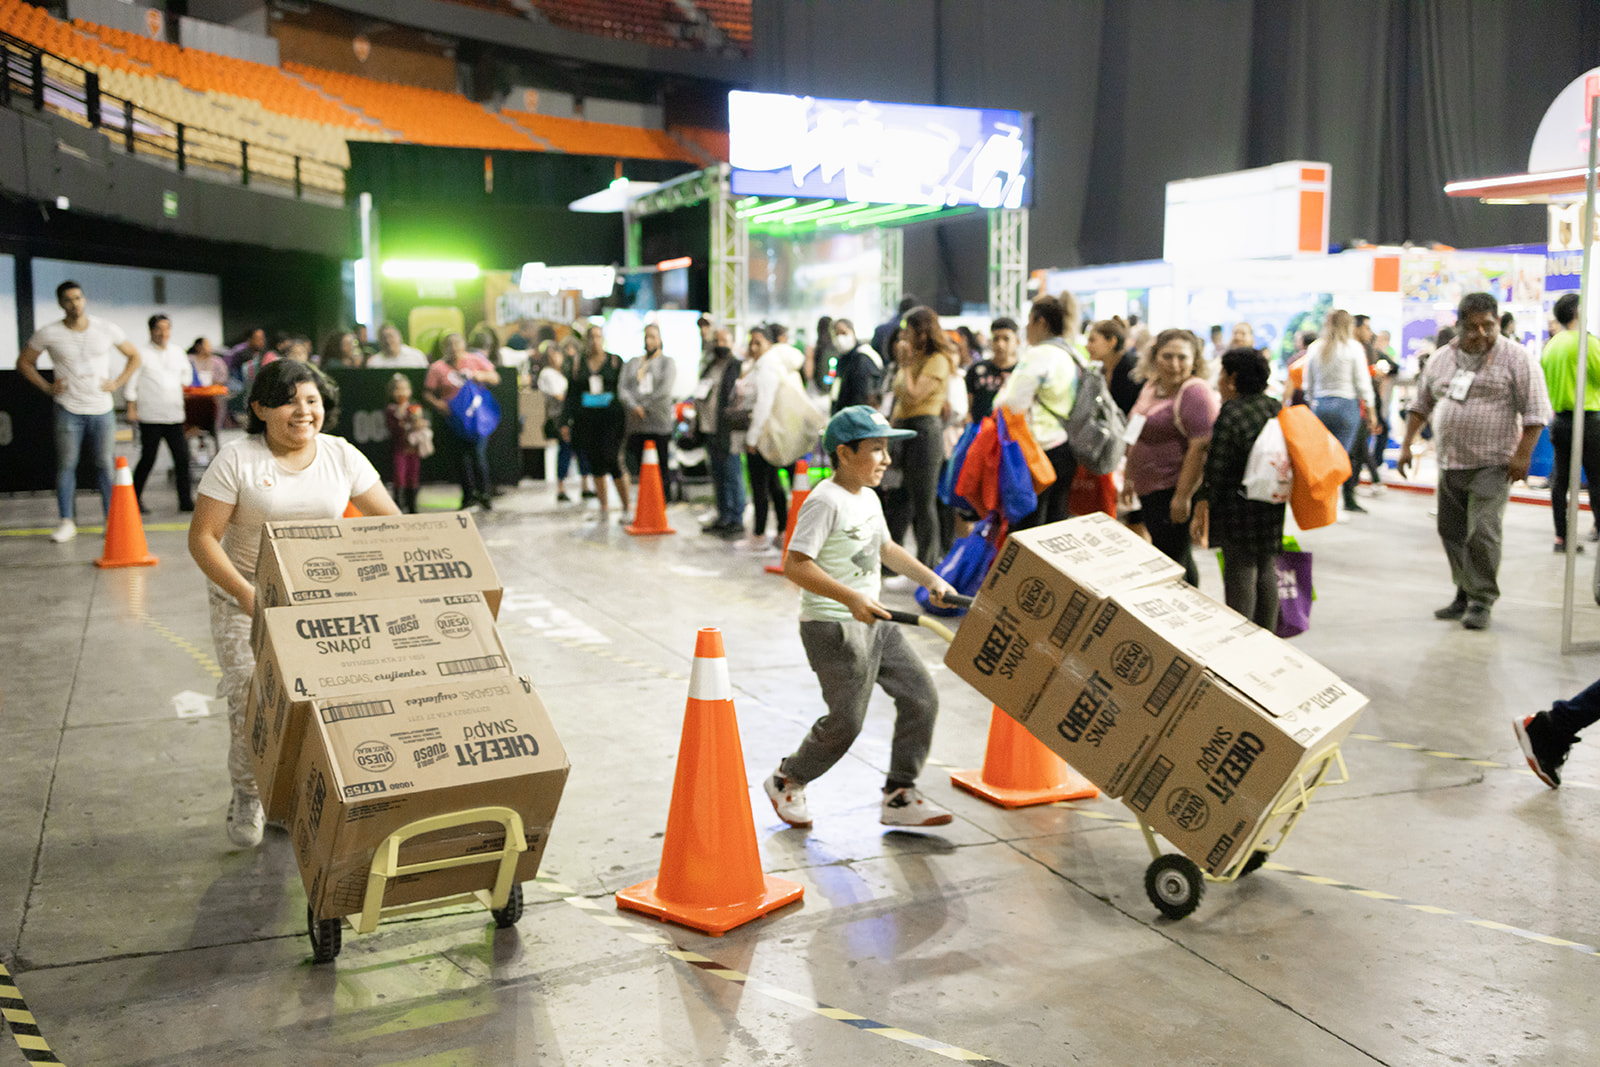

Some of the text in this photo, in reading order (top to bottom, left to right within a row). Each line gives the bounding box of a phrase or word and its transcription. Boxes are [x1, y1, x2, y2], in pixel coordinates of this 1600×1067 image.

[456, 514, 469, 529] 4
[306, 566, 340, 578] QUESO
[1021, 579, 1046, 614] QUESO
[437, 617, 470, 630] QUESO
[1115, 643, 1143, 679] QUESO
[373, 668, 427, 682] crujientes
[294, 677, 309, 697] 4
[404, 692, 458, 707] crujientes
[356, 751, 395, 766] QUESO
[344, 781, 385, 796] 14755
[1177, 792, 1205, 829] QUESO
